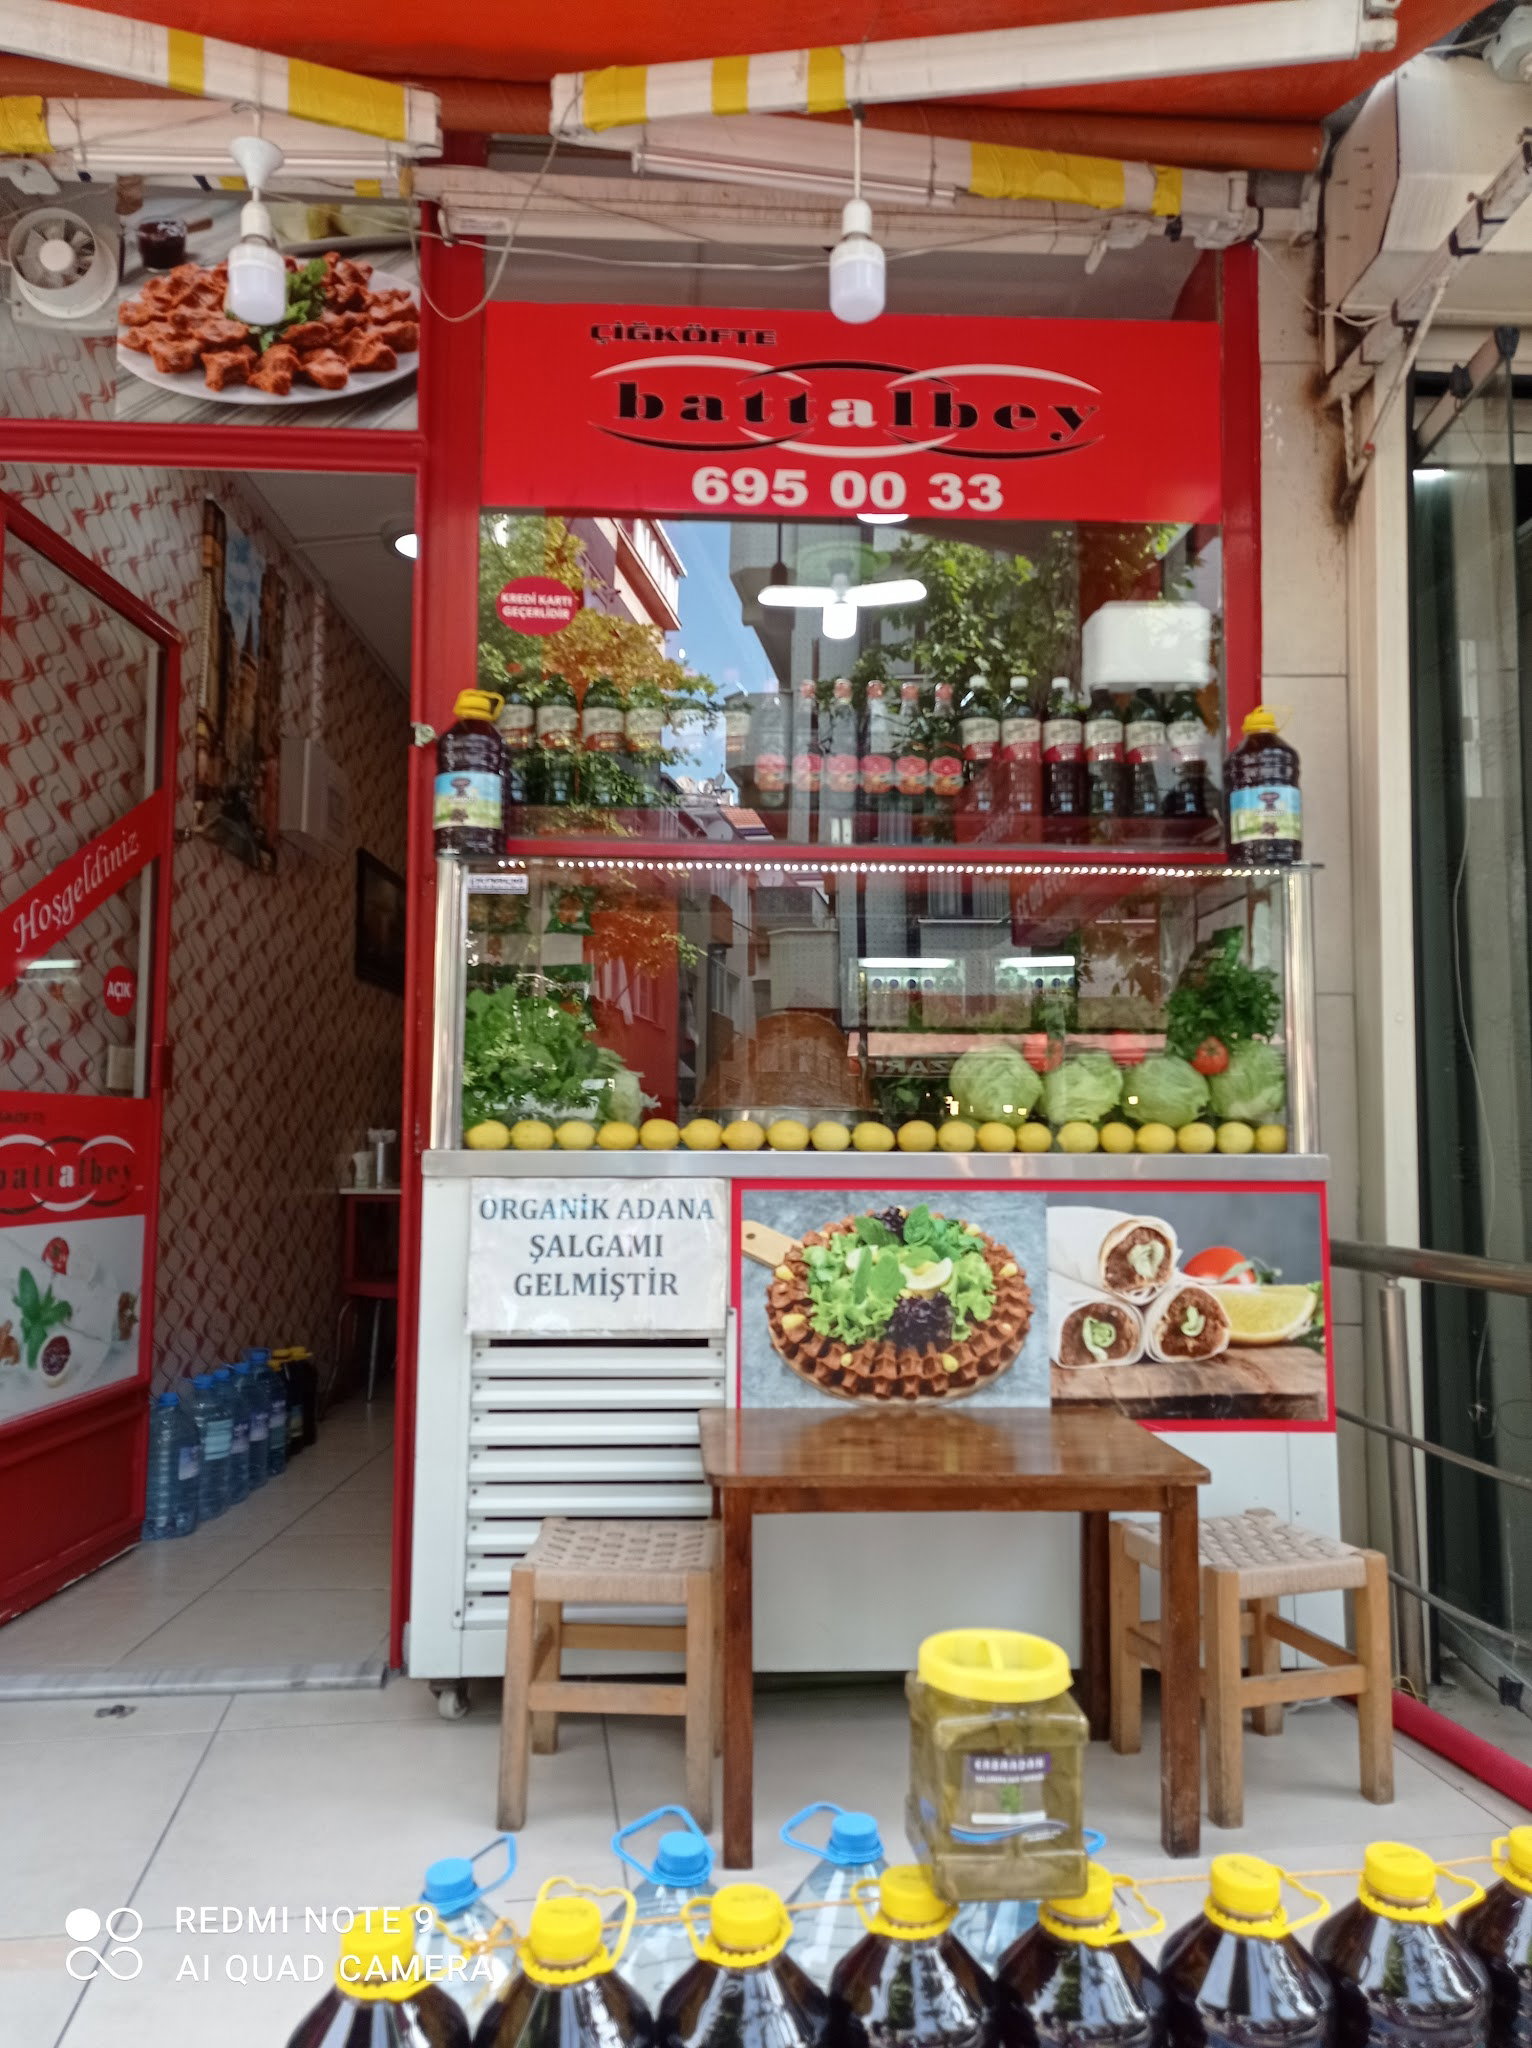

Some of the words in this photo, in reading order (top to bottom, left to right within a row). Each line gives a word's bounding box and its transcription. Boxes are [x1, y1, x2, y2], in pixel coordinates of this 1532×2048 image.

[591, 321, 778, 347] ÇİĞKÖFTE
[616, 381, 1099, 441] battalbey
[692, 466, 809, 507] 695
[830, 470, 906, 508] 00
[928, 472, 1004, 511] 33
[107, 981, 131, 1001] AÇIK
[480, 1194, 609, 1220] ORGANİK
[617, 1198, 714, 1220] ADANA
[529, 1234, 664, 1264] ŞALGAMI
[514, 1267, 679, 1302] GELMİŞTİR
